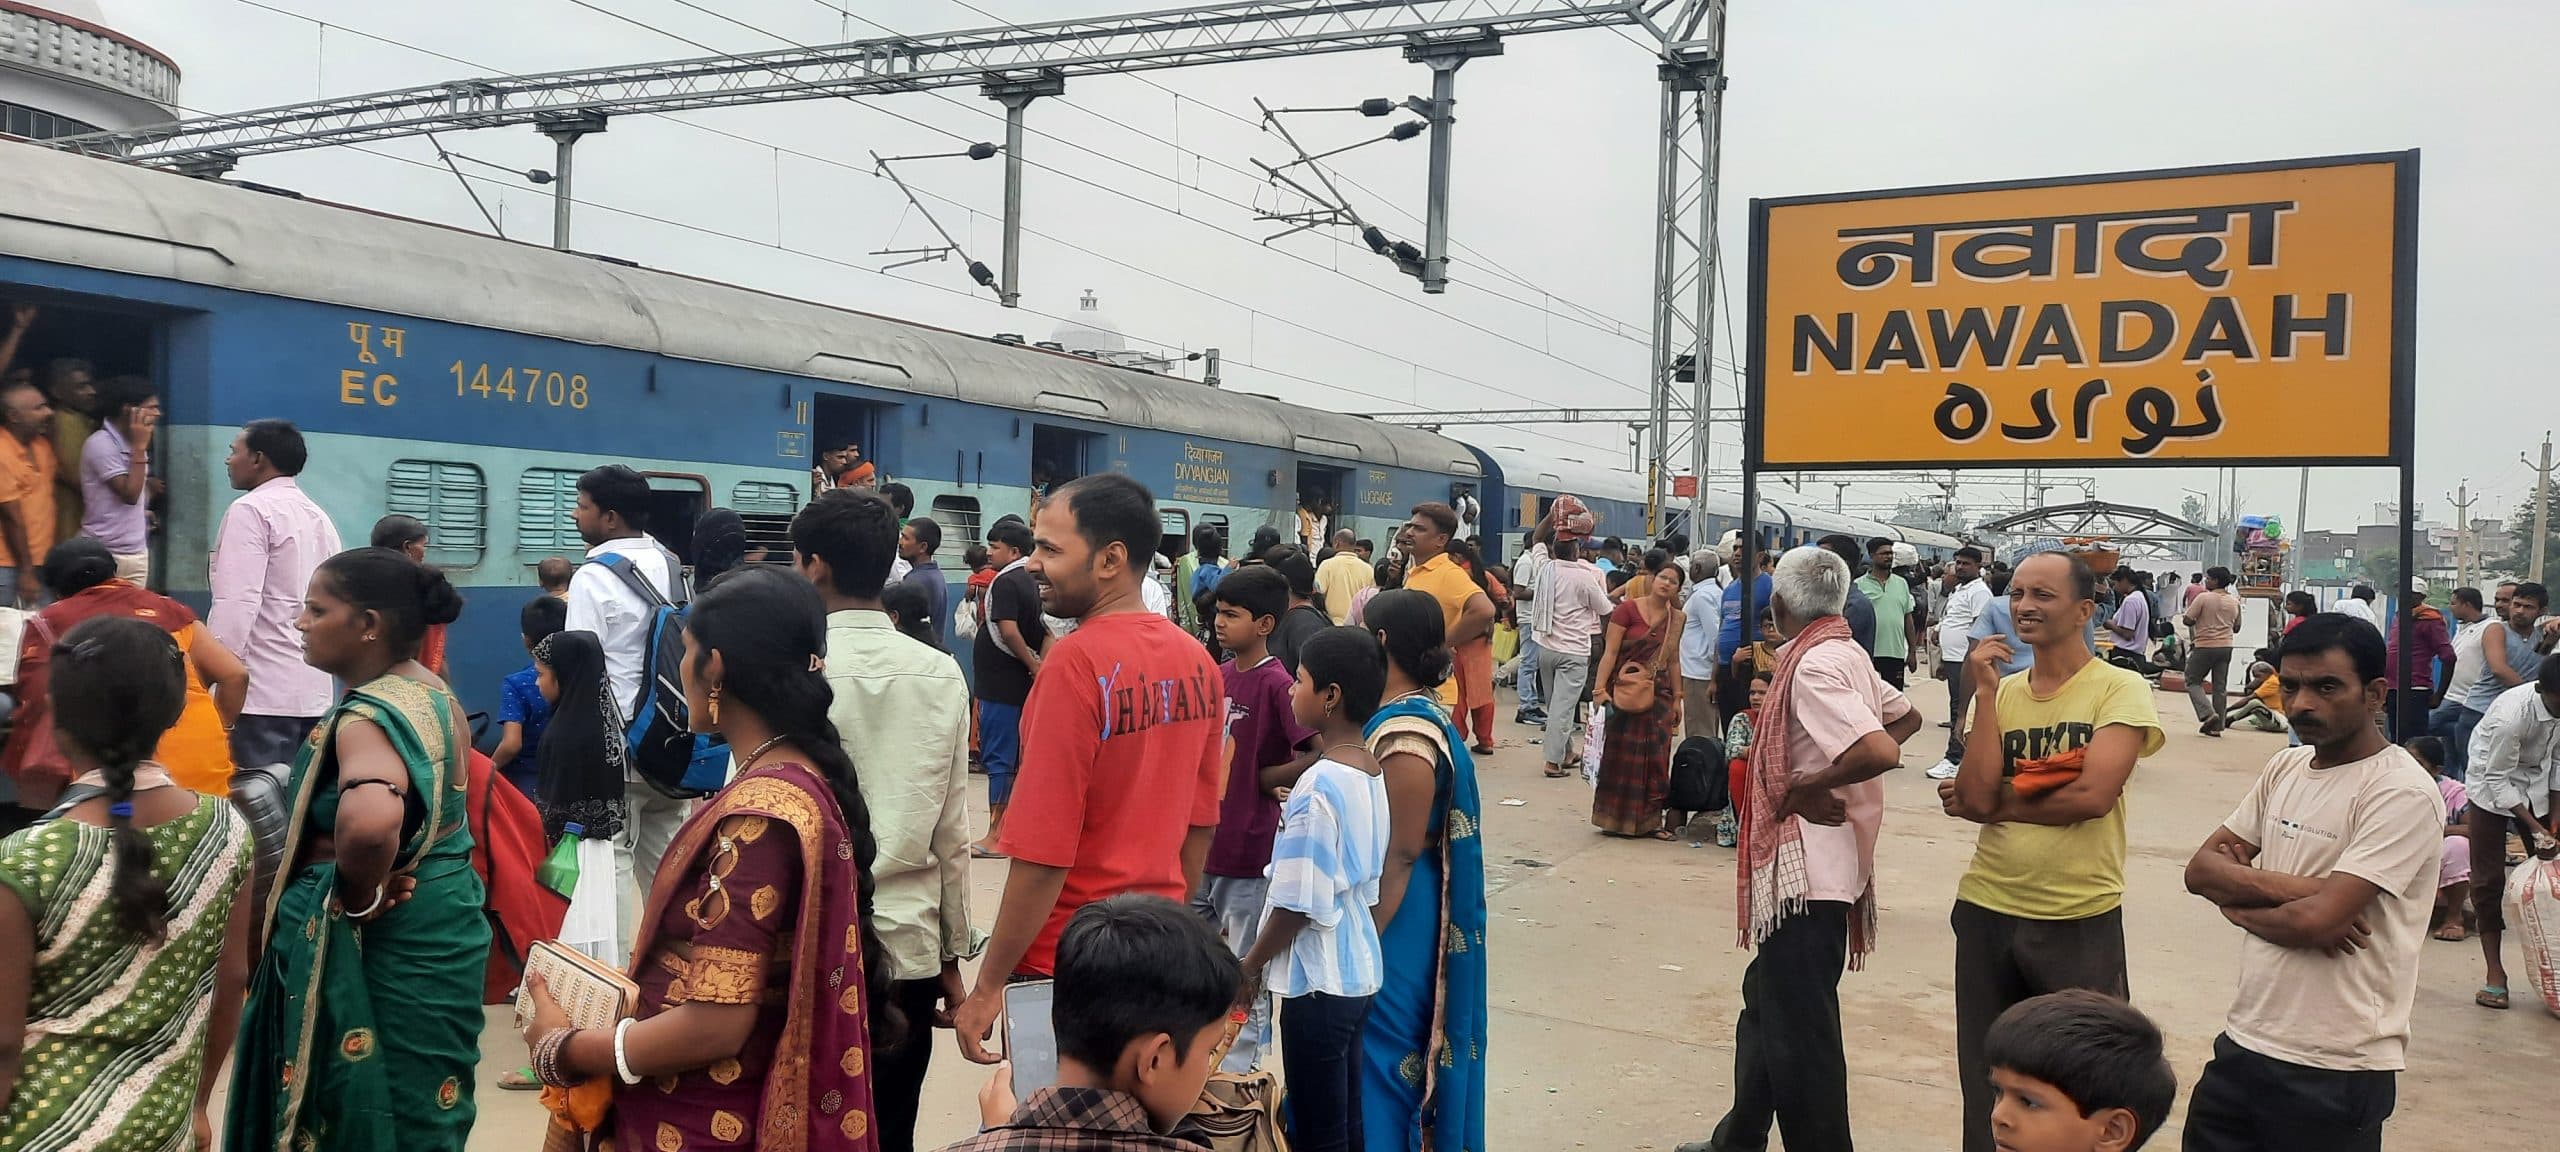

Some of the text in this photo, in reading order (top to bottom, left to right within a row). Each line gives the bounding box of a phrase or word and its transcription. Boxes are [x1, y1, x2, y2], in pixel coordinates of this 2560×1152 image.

[1836, 201, 2297, 290] नवादा
[1793, 293, 2352, 374] NAWADAH
[340, 369, 398, 406] EC
[450, 359, 589, 409] 144708
[1175, 463, 1230, 485] DIVYANGJAN
